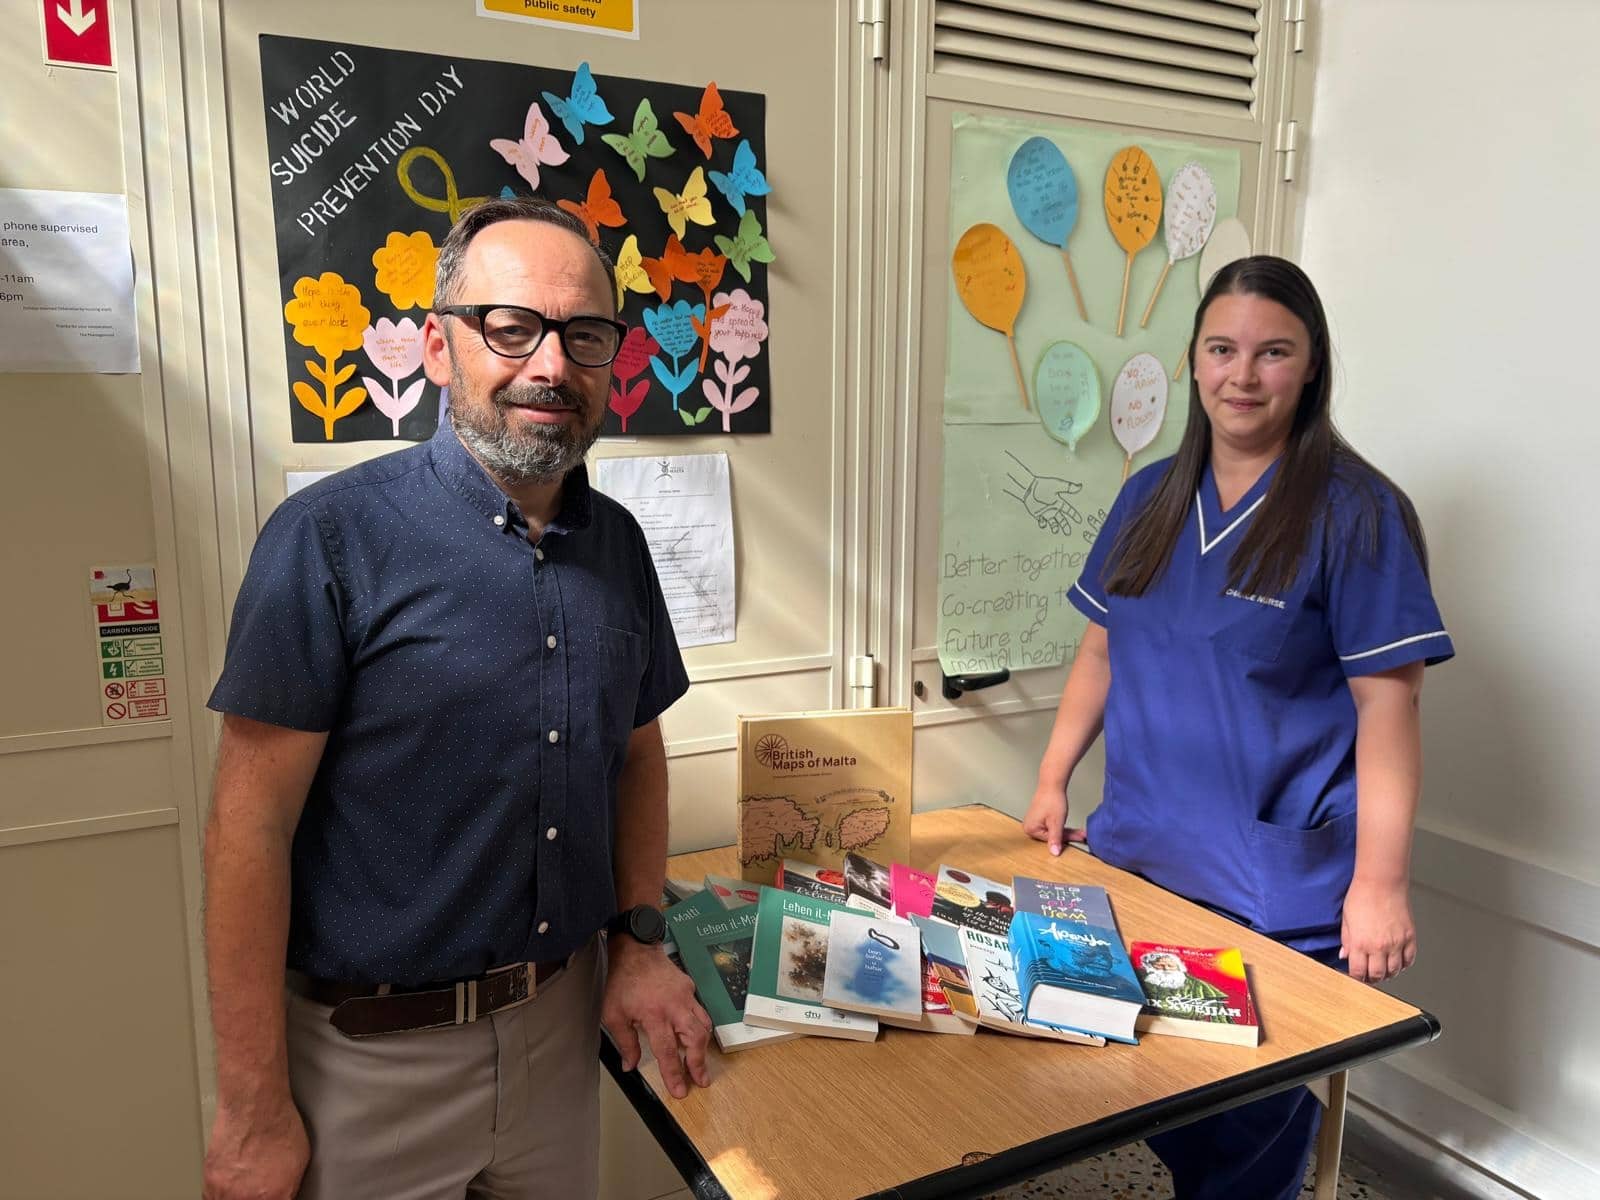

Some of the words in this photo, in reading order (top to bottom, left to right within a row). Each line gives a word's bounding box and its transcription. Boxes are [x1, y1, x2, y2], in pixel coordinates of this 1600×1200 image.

[524, 0, 559, 11] public
[562, 5, 596, 18] safety
[271, 51, 355, 125] WORLD
[271, 101, 358, 185] SUICIDE
[296, 113, 422, 236] PREVENTION
[418, 65, 464, 116] DAY
[4, 221, 38, 233] phone
[40, 223, 99, 234] supervised
[1, 238, 29, 248] area,
[1127, 401, 1142, 411] NO
[944, 552, 1008, 579] Better
[941, 589, 1049, 623] Co-creating
[101, 627, 130, 635] CARBON
[1019, 619, 1044, 644] of
[950, 650, 1013, 674] mental
[772, 748, 814, 761] British
[772, 759, 805, 772] Maps
[807, 757, 821, 768] of
[823, 756, 857, 767] Malta
[672, 904, 700, 923] Malti
